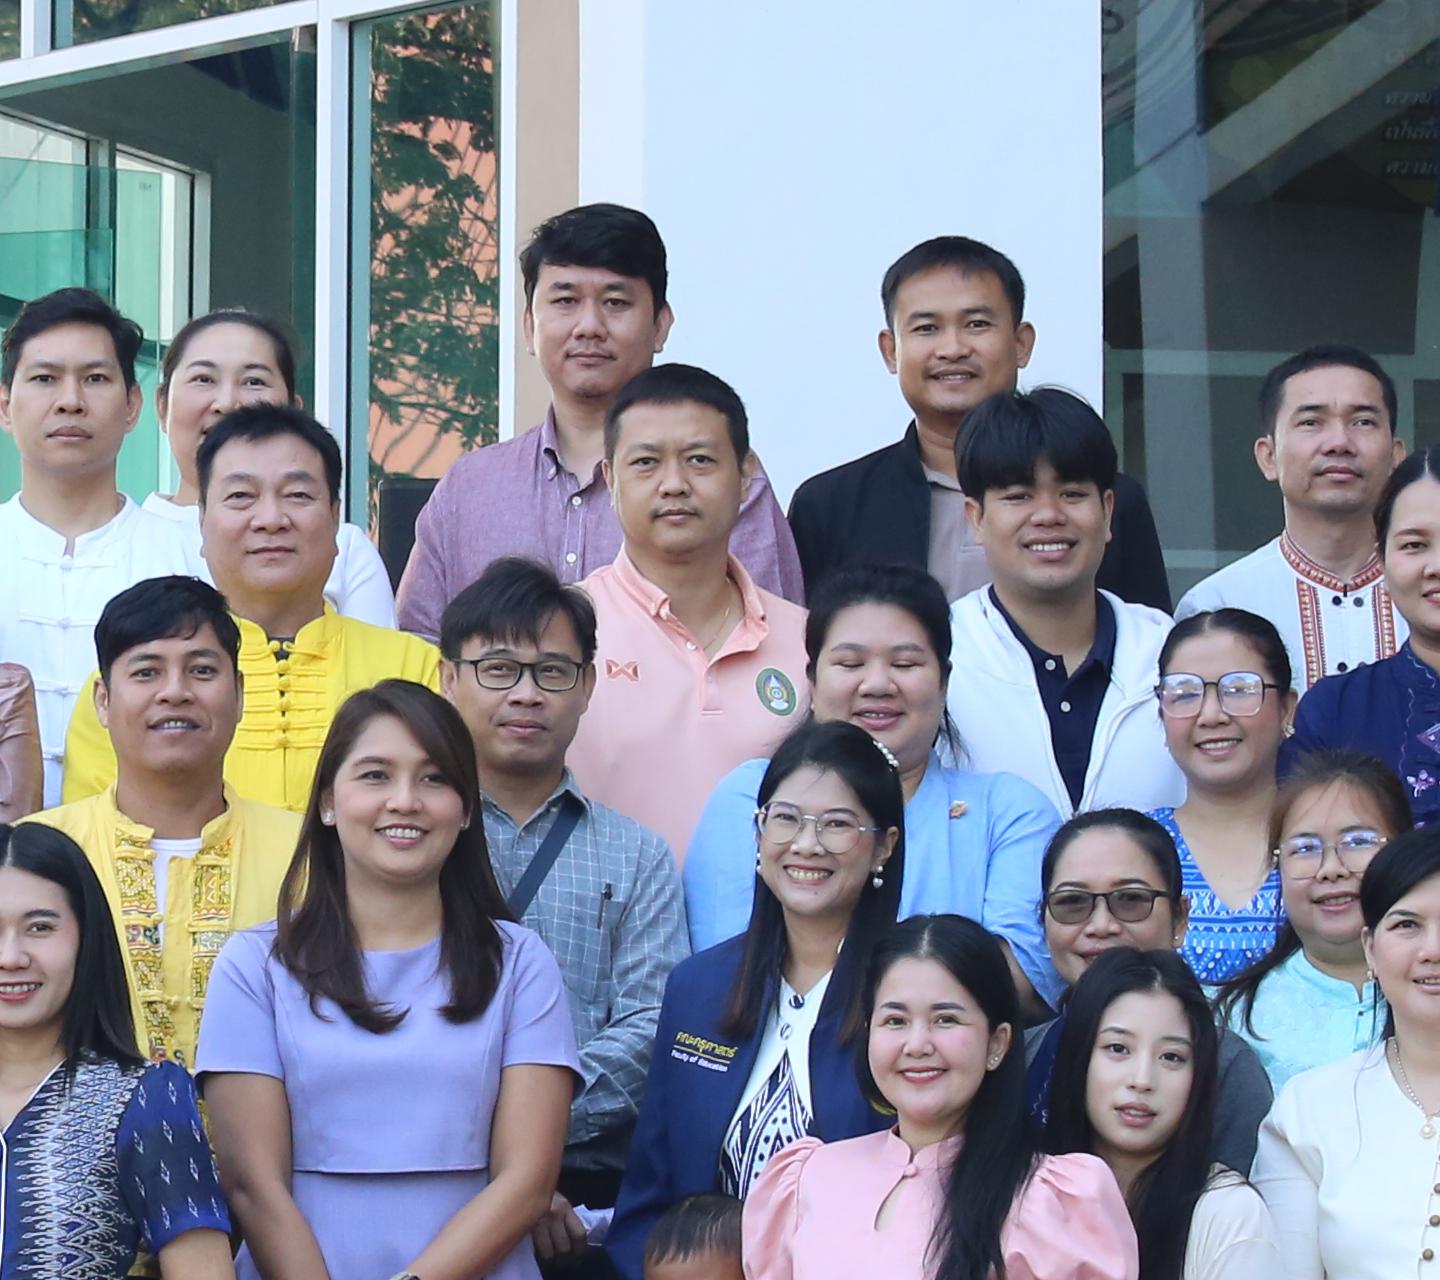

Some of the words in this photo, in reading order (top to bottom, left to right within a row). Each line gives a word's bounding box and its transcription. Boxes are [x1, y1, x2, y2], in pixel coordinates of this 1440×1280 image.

[671, 1049, 689, 1062] Faculty
[689, 1055, 698, 1063] of
[697, 1058, 728, 1073] Education
